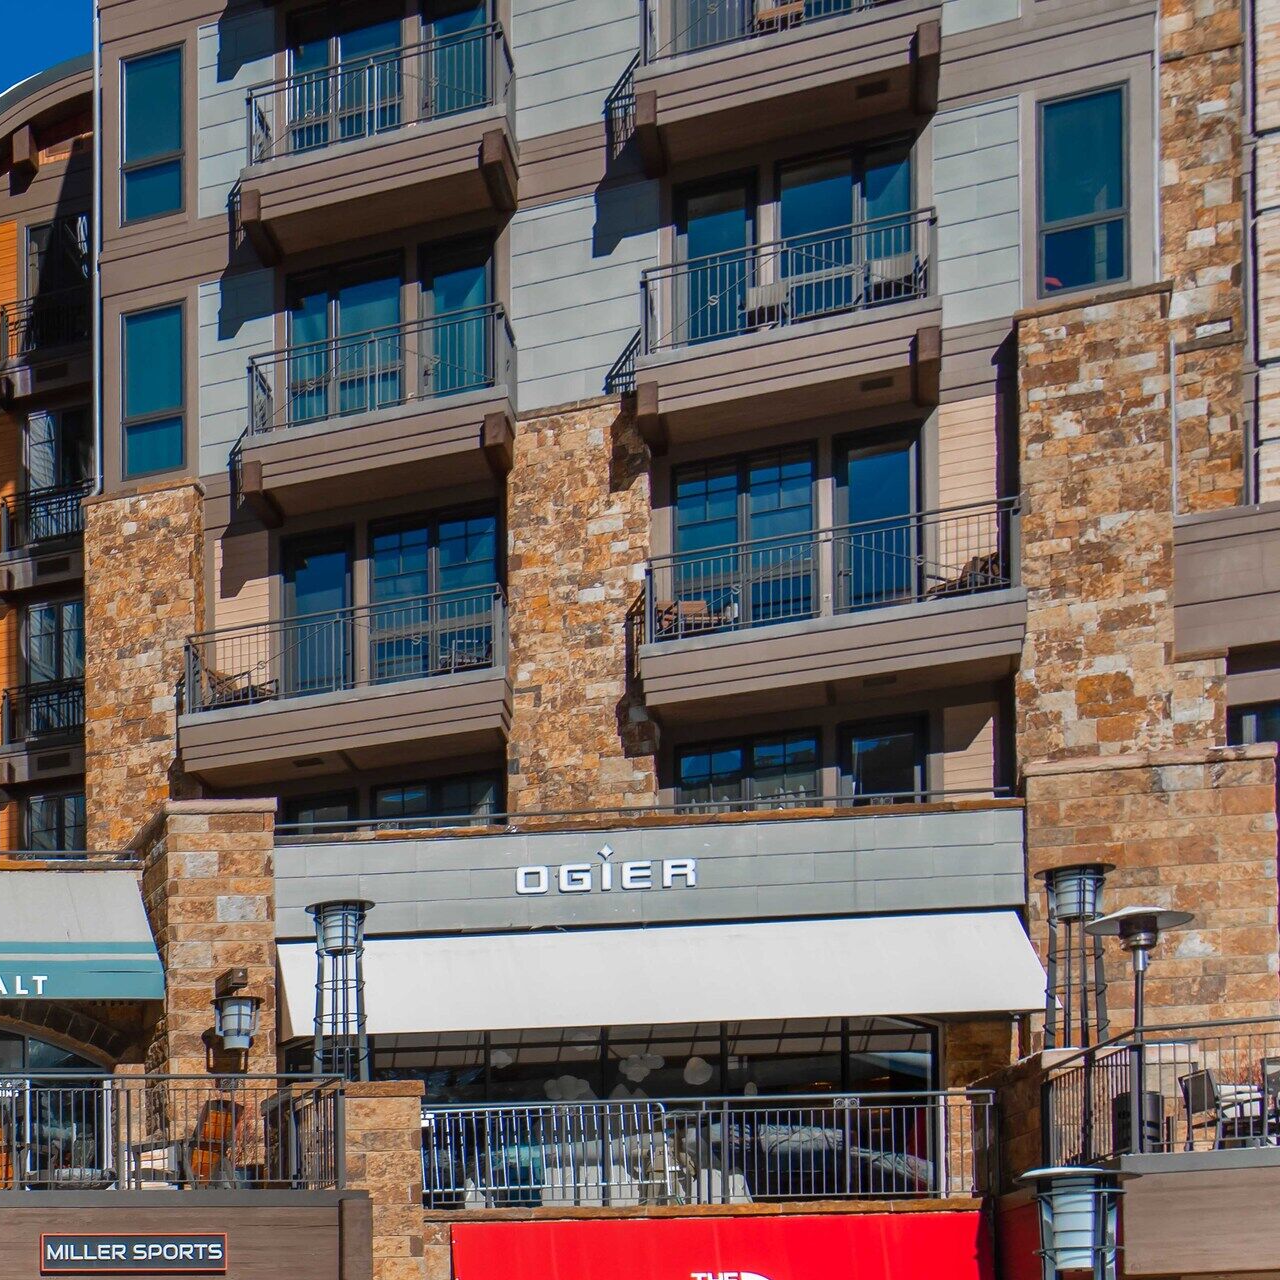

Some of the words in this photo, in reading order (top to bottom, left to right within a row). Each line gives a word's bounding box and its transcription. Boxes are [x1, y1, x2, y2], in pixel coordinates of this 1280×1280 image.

[516, 845, 696, 894] OGIER
[46, 1244, 127, 1260] MILLER
[132, 1243, 223, 1260] SPORTS
